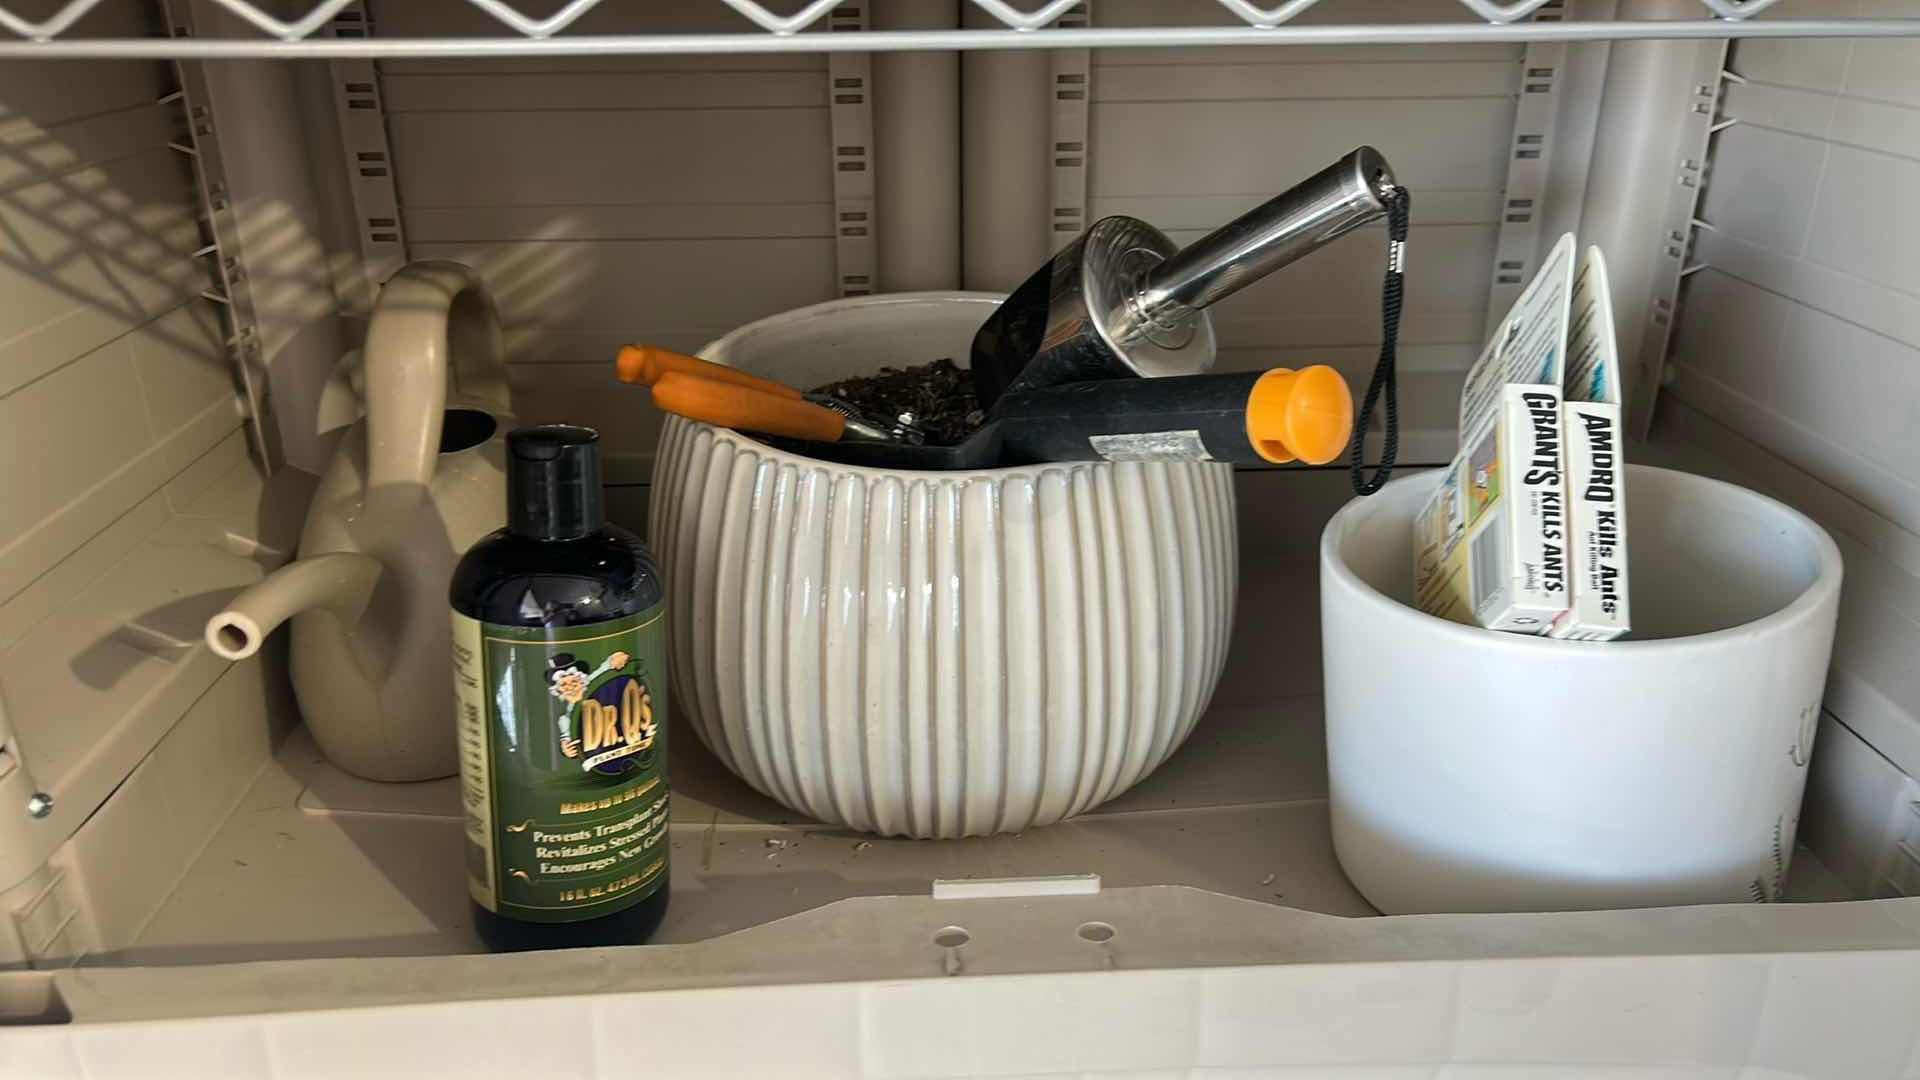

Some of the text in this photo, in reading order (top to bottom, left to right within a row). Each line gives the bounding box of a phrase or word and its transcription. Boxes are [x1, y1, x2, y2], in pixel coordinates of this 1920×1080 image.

[1577, 411, 1615, 503] AMDRO
[1522, 392, 1564, 593] GRANT'S KILLS ANTS
[1597, 510, 1618, 559] Kills
[1599, 564, 1619, 614] Ants
[533, 830, 592, 843] Prevents
[594, 808, 652, 837] Transplant
[536, 843, 607, 859] Revitalizes
[608, 822, 651, 849] Stressed
[540, 845, 642, 874] Encourages New
